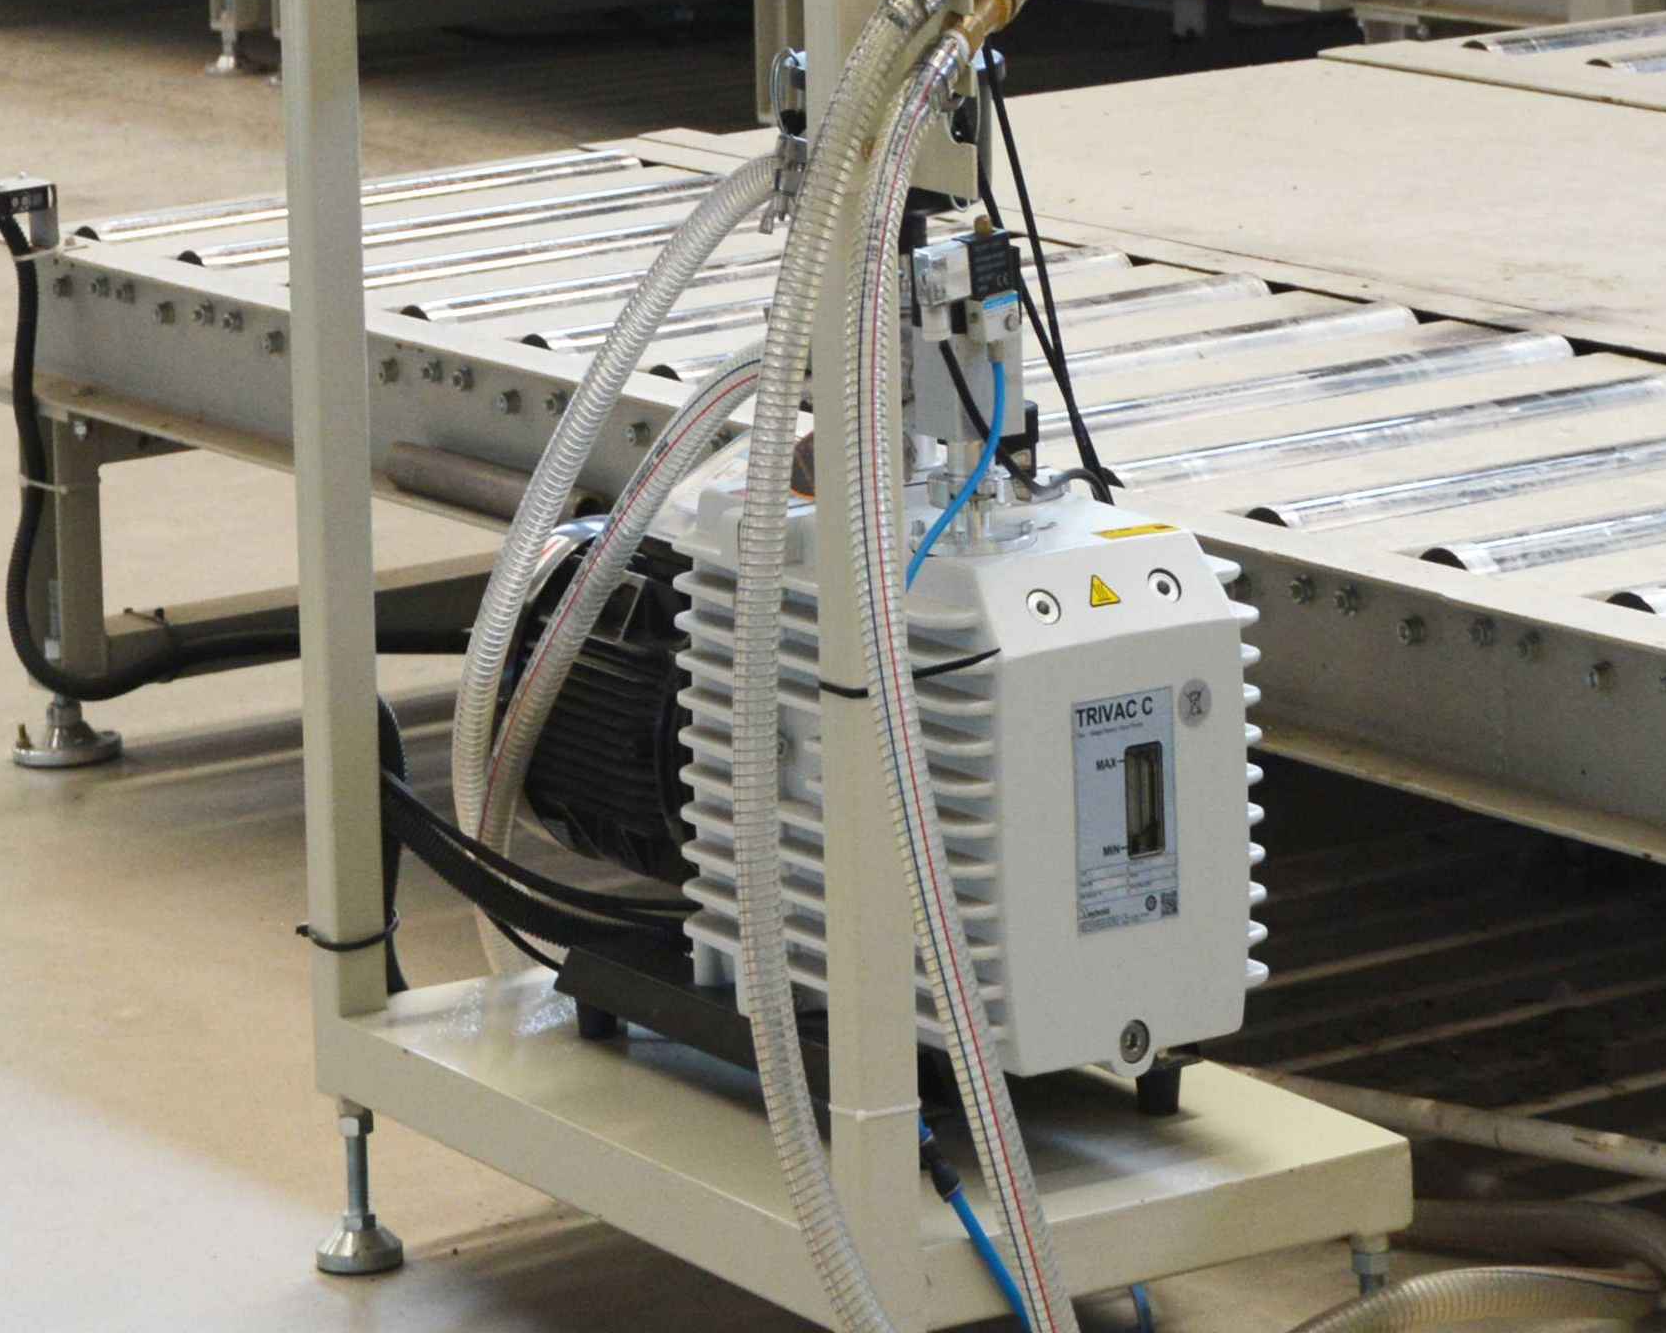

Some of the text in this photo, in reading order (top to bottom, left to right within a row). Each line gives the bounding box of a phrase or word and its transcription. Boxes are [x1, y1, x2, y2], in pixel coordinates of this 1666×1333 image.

[1076, 696, 1153, 728] TRIVAC C
[1096, 758, 1117, 771] MAX
[1103, 845, 1120, 856] MIN
